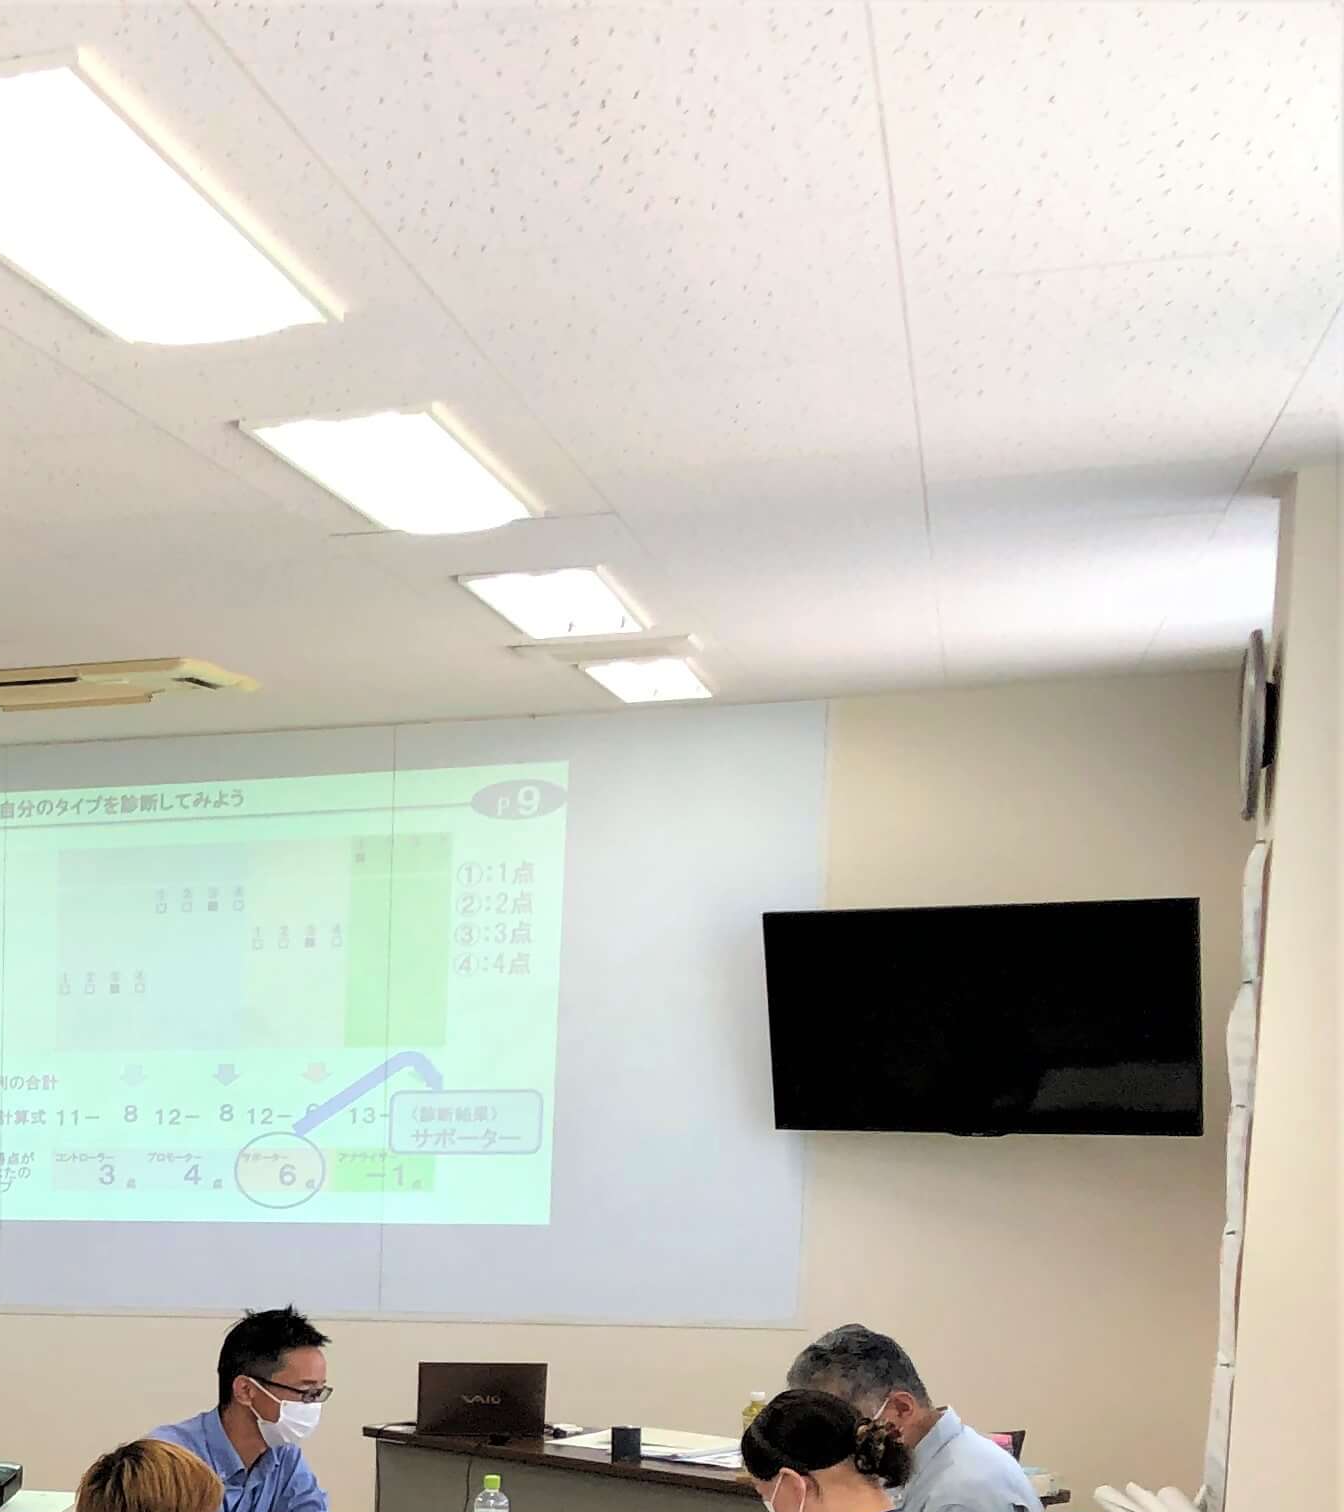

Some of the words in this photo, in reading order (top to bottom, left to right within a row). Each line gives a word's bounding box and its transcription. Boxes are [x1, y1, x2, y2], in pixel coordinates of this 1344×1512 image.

[123, 1104, 139, 1123] 8
[219, 1103, 234, 1123] 8
[411, 1128, 521, 1149] サポーター
[99, 1163, 115, 1185] 3
[183, 1163, 202, 1186] 4
[278, 1164, 297, 1187] 6
